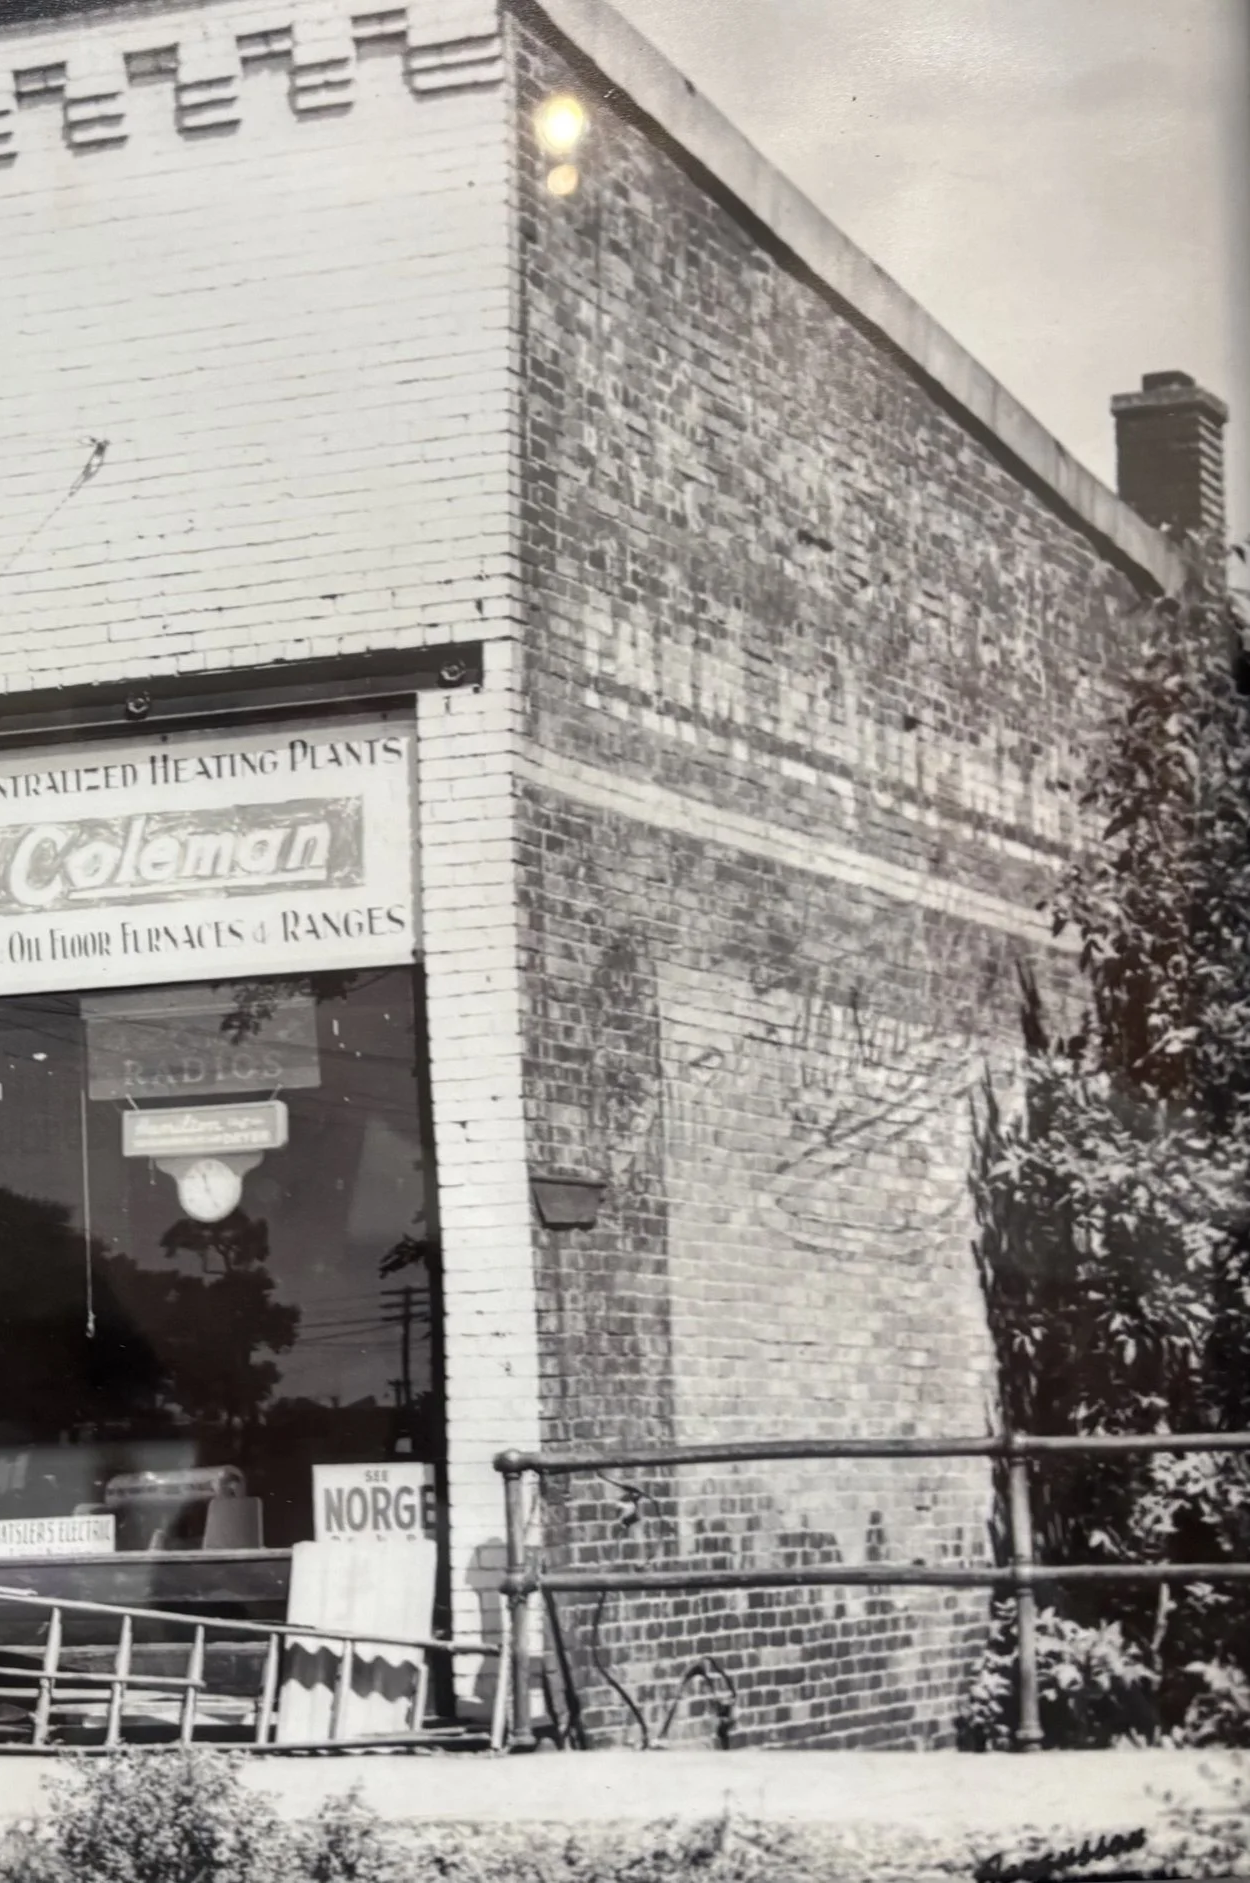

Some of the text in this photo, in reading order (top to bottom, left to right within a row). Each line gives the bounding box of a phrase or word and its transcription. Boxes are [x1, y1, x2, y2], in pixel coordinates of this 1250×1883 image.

[149, 751, 279, 786] HEATING
[288, 736, 403, 773] PLANTS
[7, 812, 333, 909] Coleman
[8, 931, 43, 964] OIL
[49, 928, 111, 961] FLOOR
[121, 917, 246, 957] FURNACES
[281, 903, 408, 944] RANGES
[123, 1050, 285, 1086] RADIOS
[365, 1470, 389, 1482] SEE
[324, 1485, 434, 1533] NORGE
